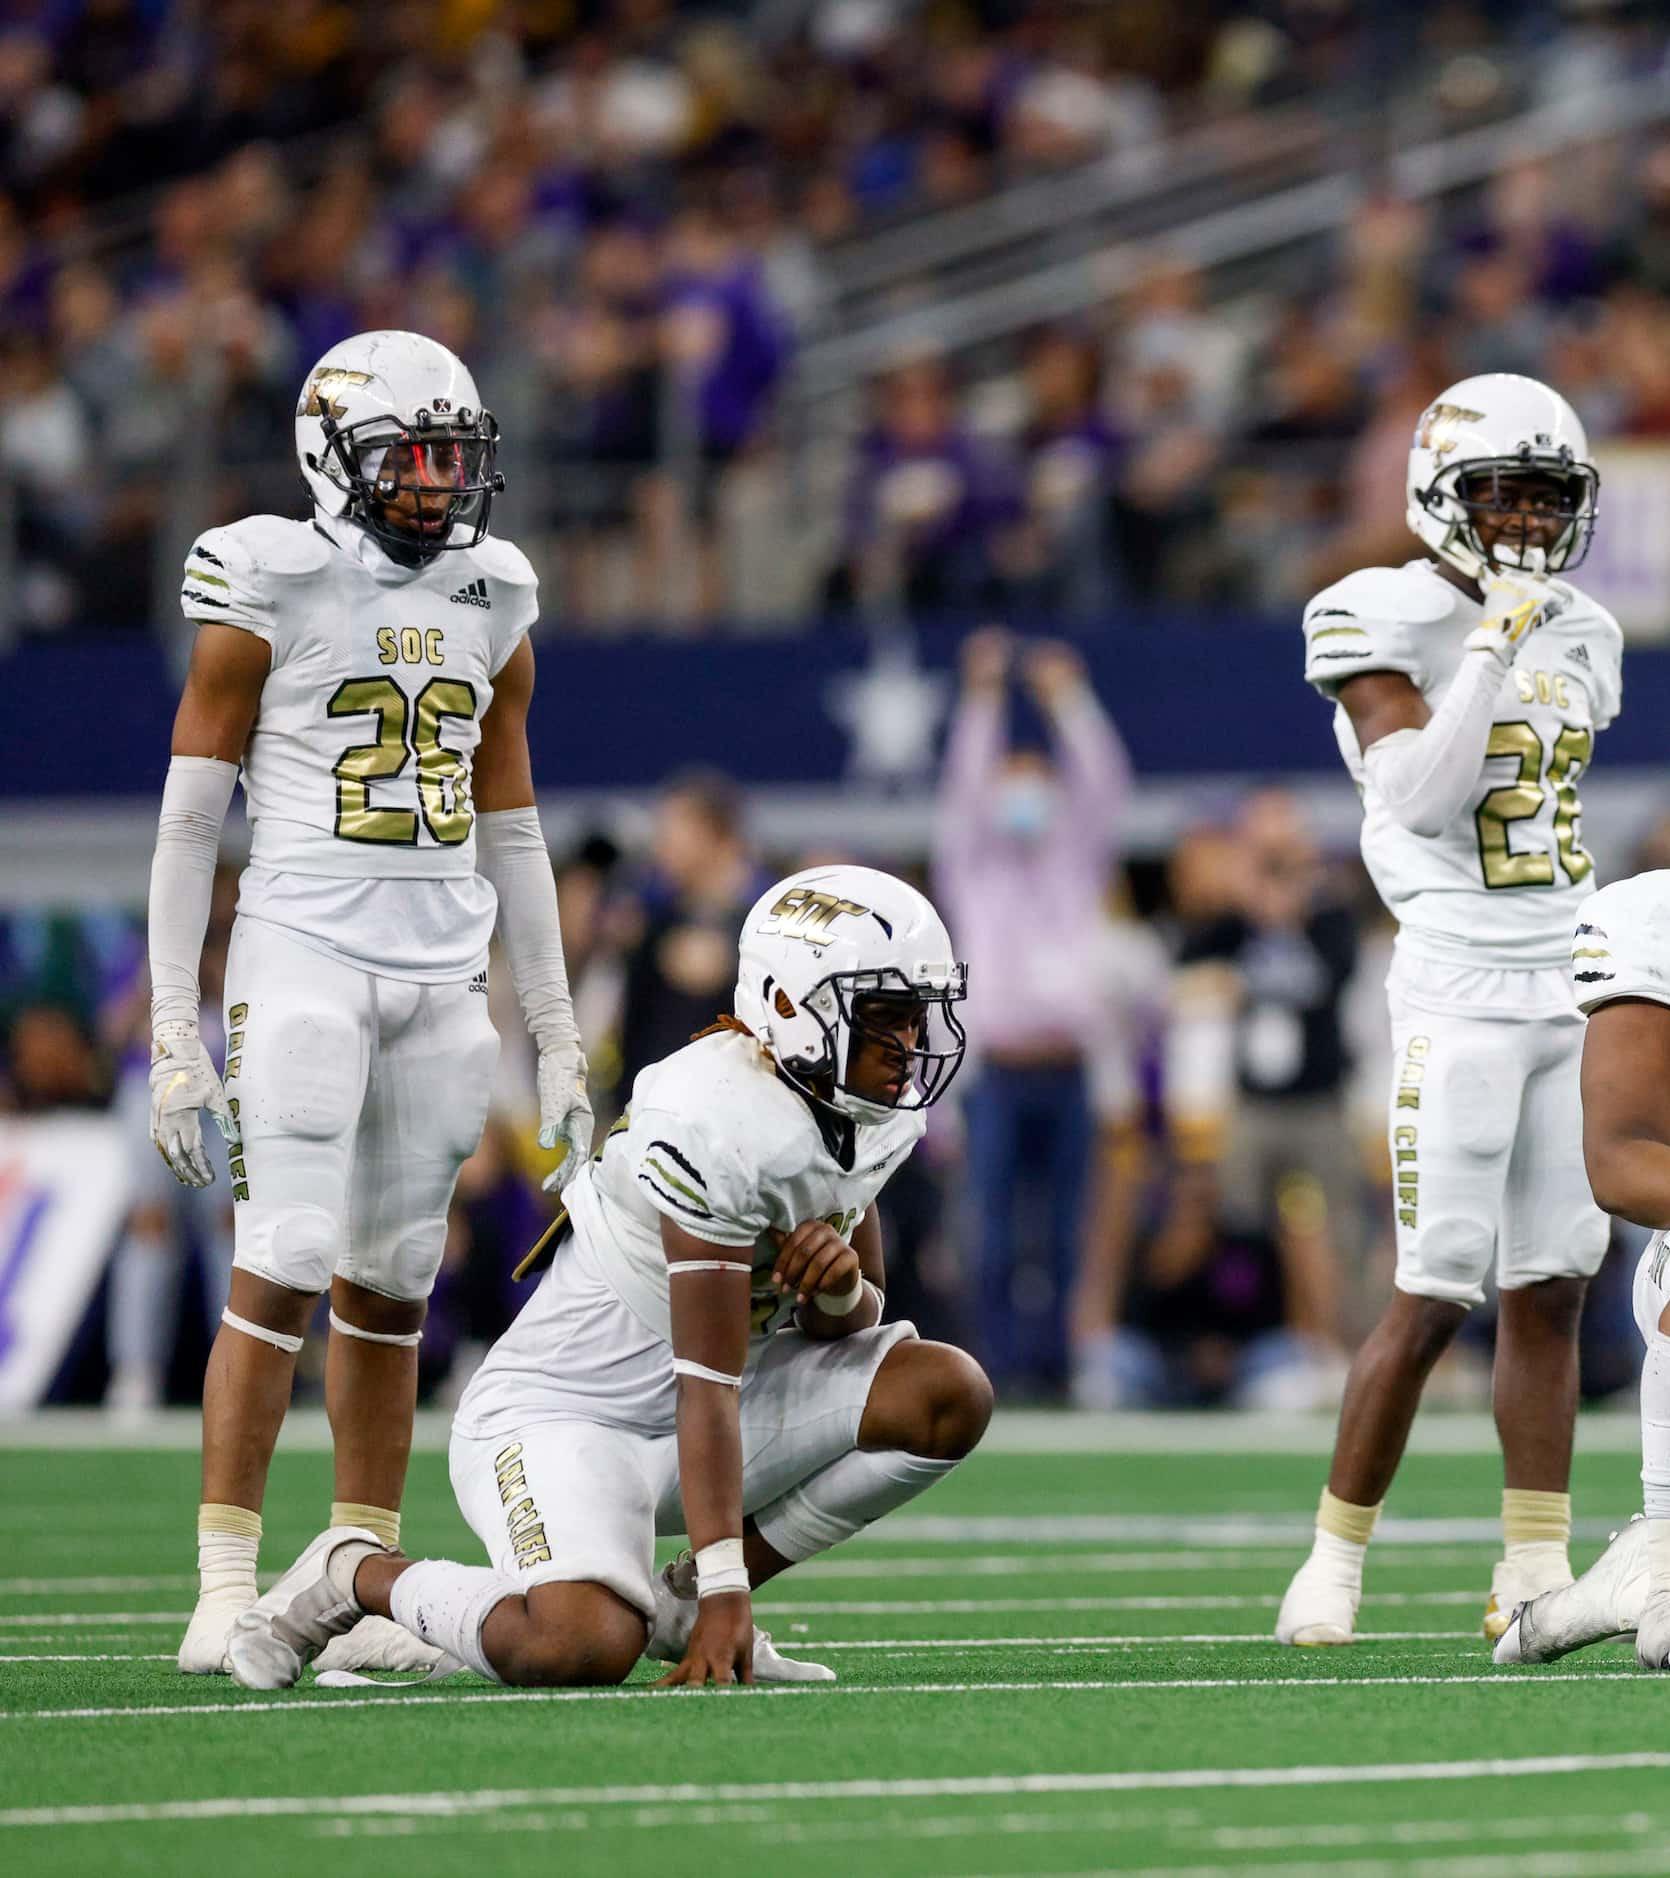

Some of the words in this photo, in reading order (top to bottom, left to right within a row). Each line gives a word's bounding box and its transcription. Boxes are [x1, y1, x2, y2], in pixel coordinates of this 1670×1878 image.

[450, 592, 491, 610] adidas
[376, 626, 444, 665] SOC
[1514, 670, 1569, 709] SOC
[327, 674, 477, 847] 26
[1394, 1125, 1419, 1230] CLIFF
[494, 1442, 528, 1507] OAK
[506, 1497, 552, 1570] CLIFF
